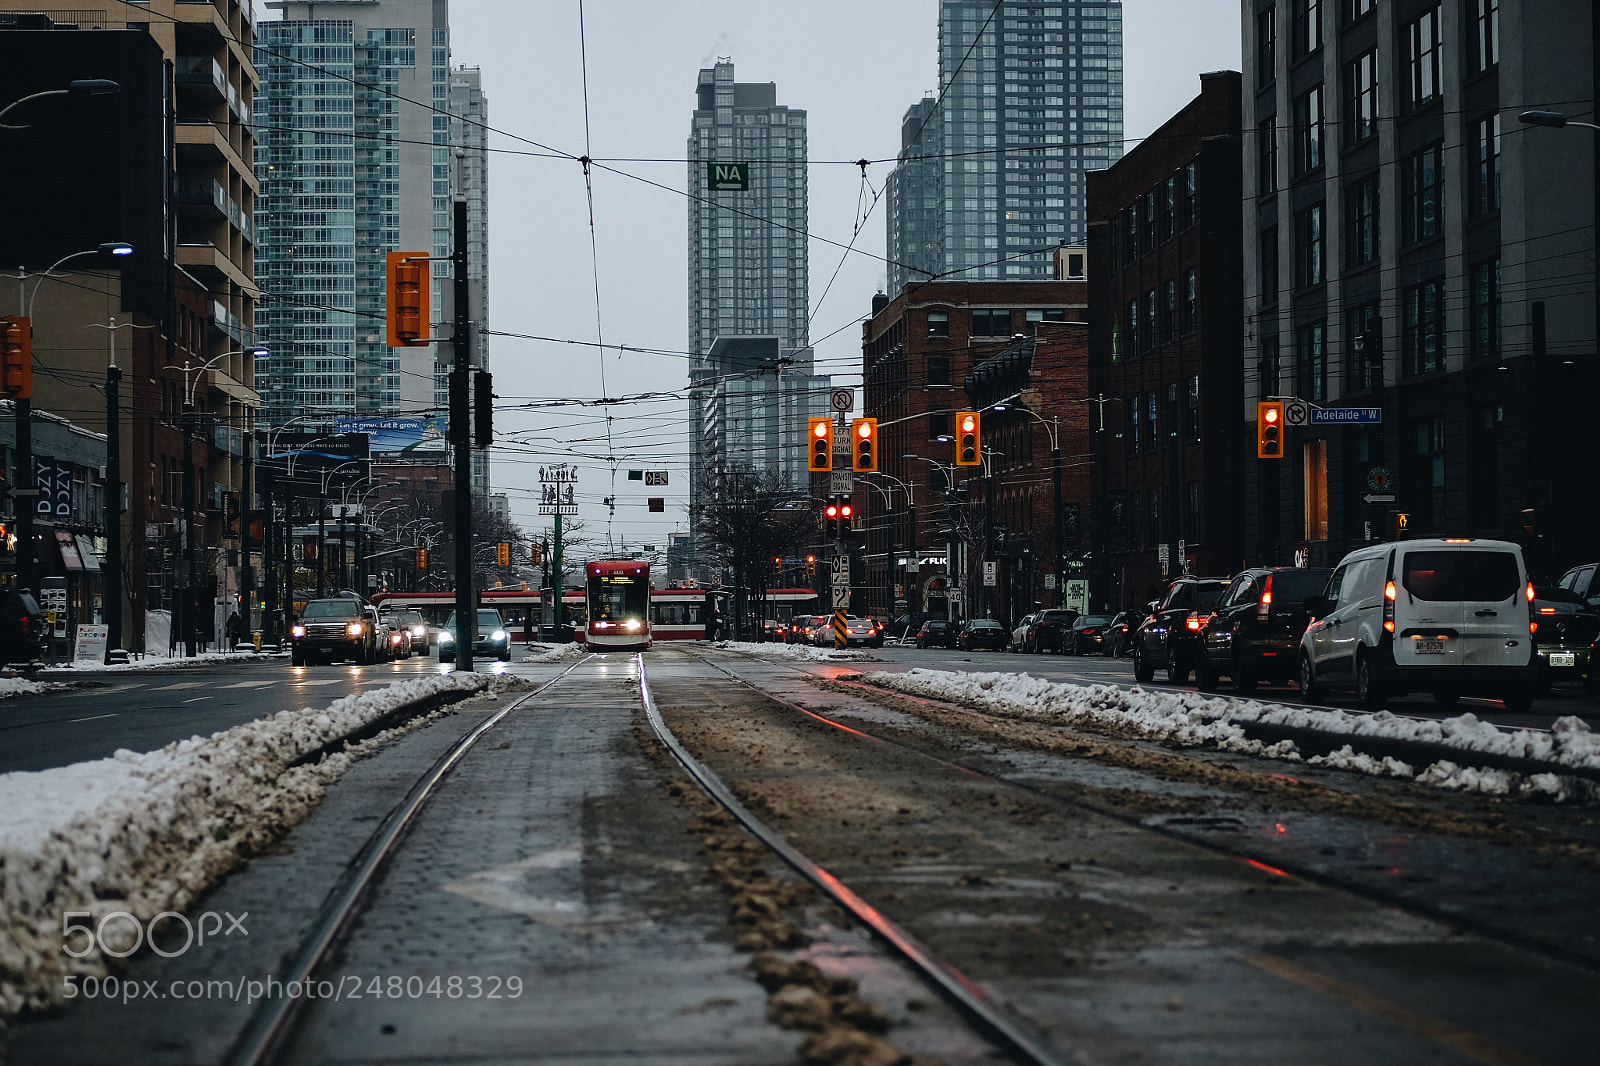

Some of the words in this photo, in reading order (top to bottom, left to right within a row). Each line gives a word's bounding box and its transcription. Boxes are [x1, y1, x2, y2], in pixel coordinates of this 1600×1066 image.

[715, 165, 742, 181] NA
[1316, 410, 1359, 421] Adelaide
[1368, 410, 1377, 420] W
[833, 428, 851, 436] LEFT
[832, 445, 852, 454] SIGNAL
[832, 473, 852, 481] TRANSIT
[833, 482, 851, 491] SIGNAL
